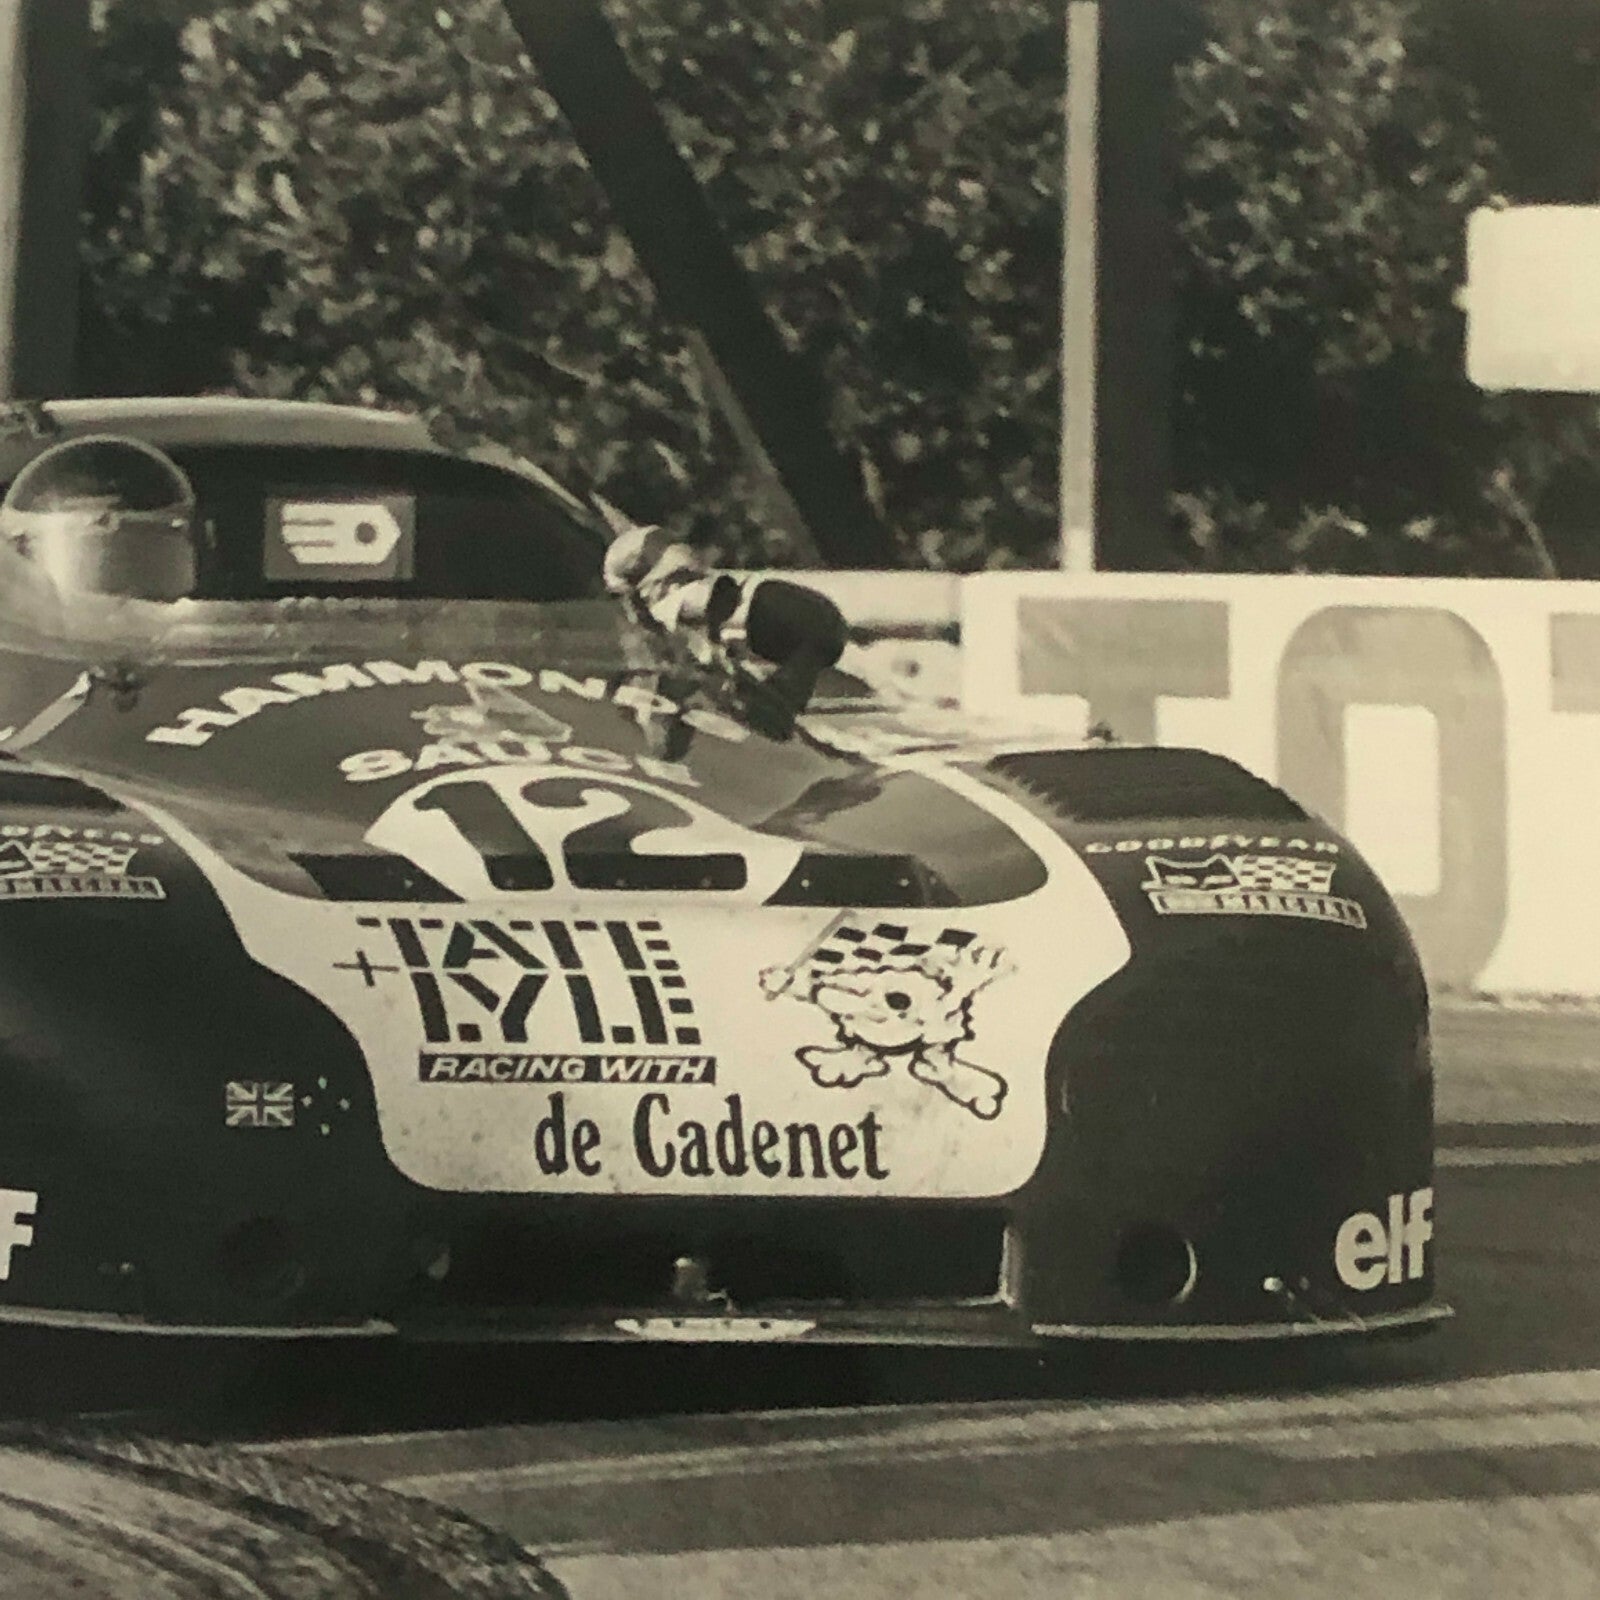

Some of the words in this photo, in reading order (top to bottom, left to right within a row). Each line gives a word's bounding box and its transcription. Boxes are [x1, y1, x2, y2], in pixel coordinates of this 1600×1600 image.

[413, 777, 747, 891] 12
[1017, 598, 1600, 992] TO
[1085, 834, 1340, 853] GOODYEAR
[357, 917, 681, 970] TATE
[410, 972, 701, 1045] LYLE
[429, 1056, 587, 1081] RACING
[599, 1058, 706, 1082] WITH
[535, 1091, 602, 1177] de
[633, 1092, 891, 1180] Cadenet
[1335, 1187, 1434, 1291] elf
